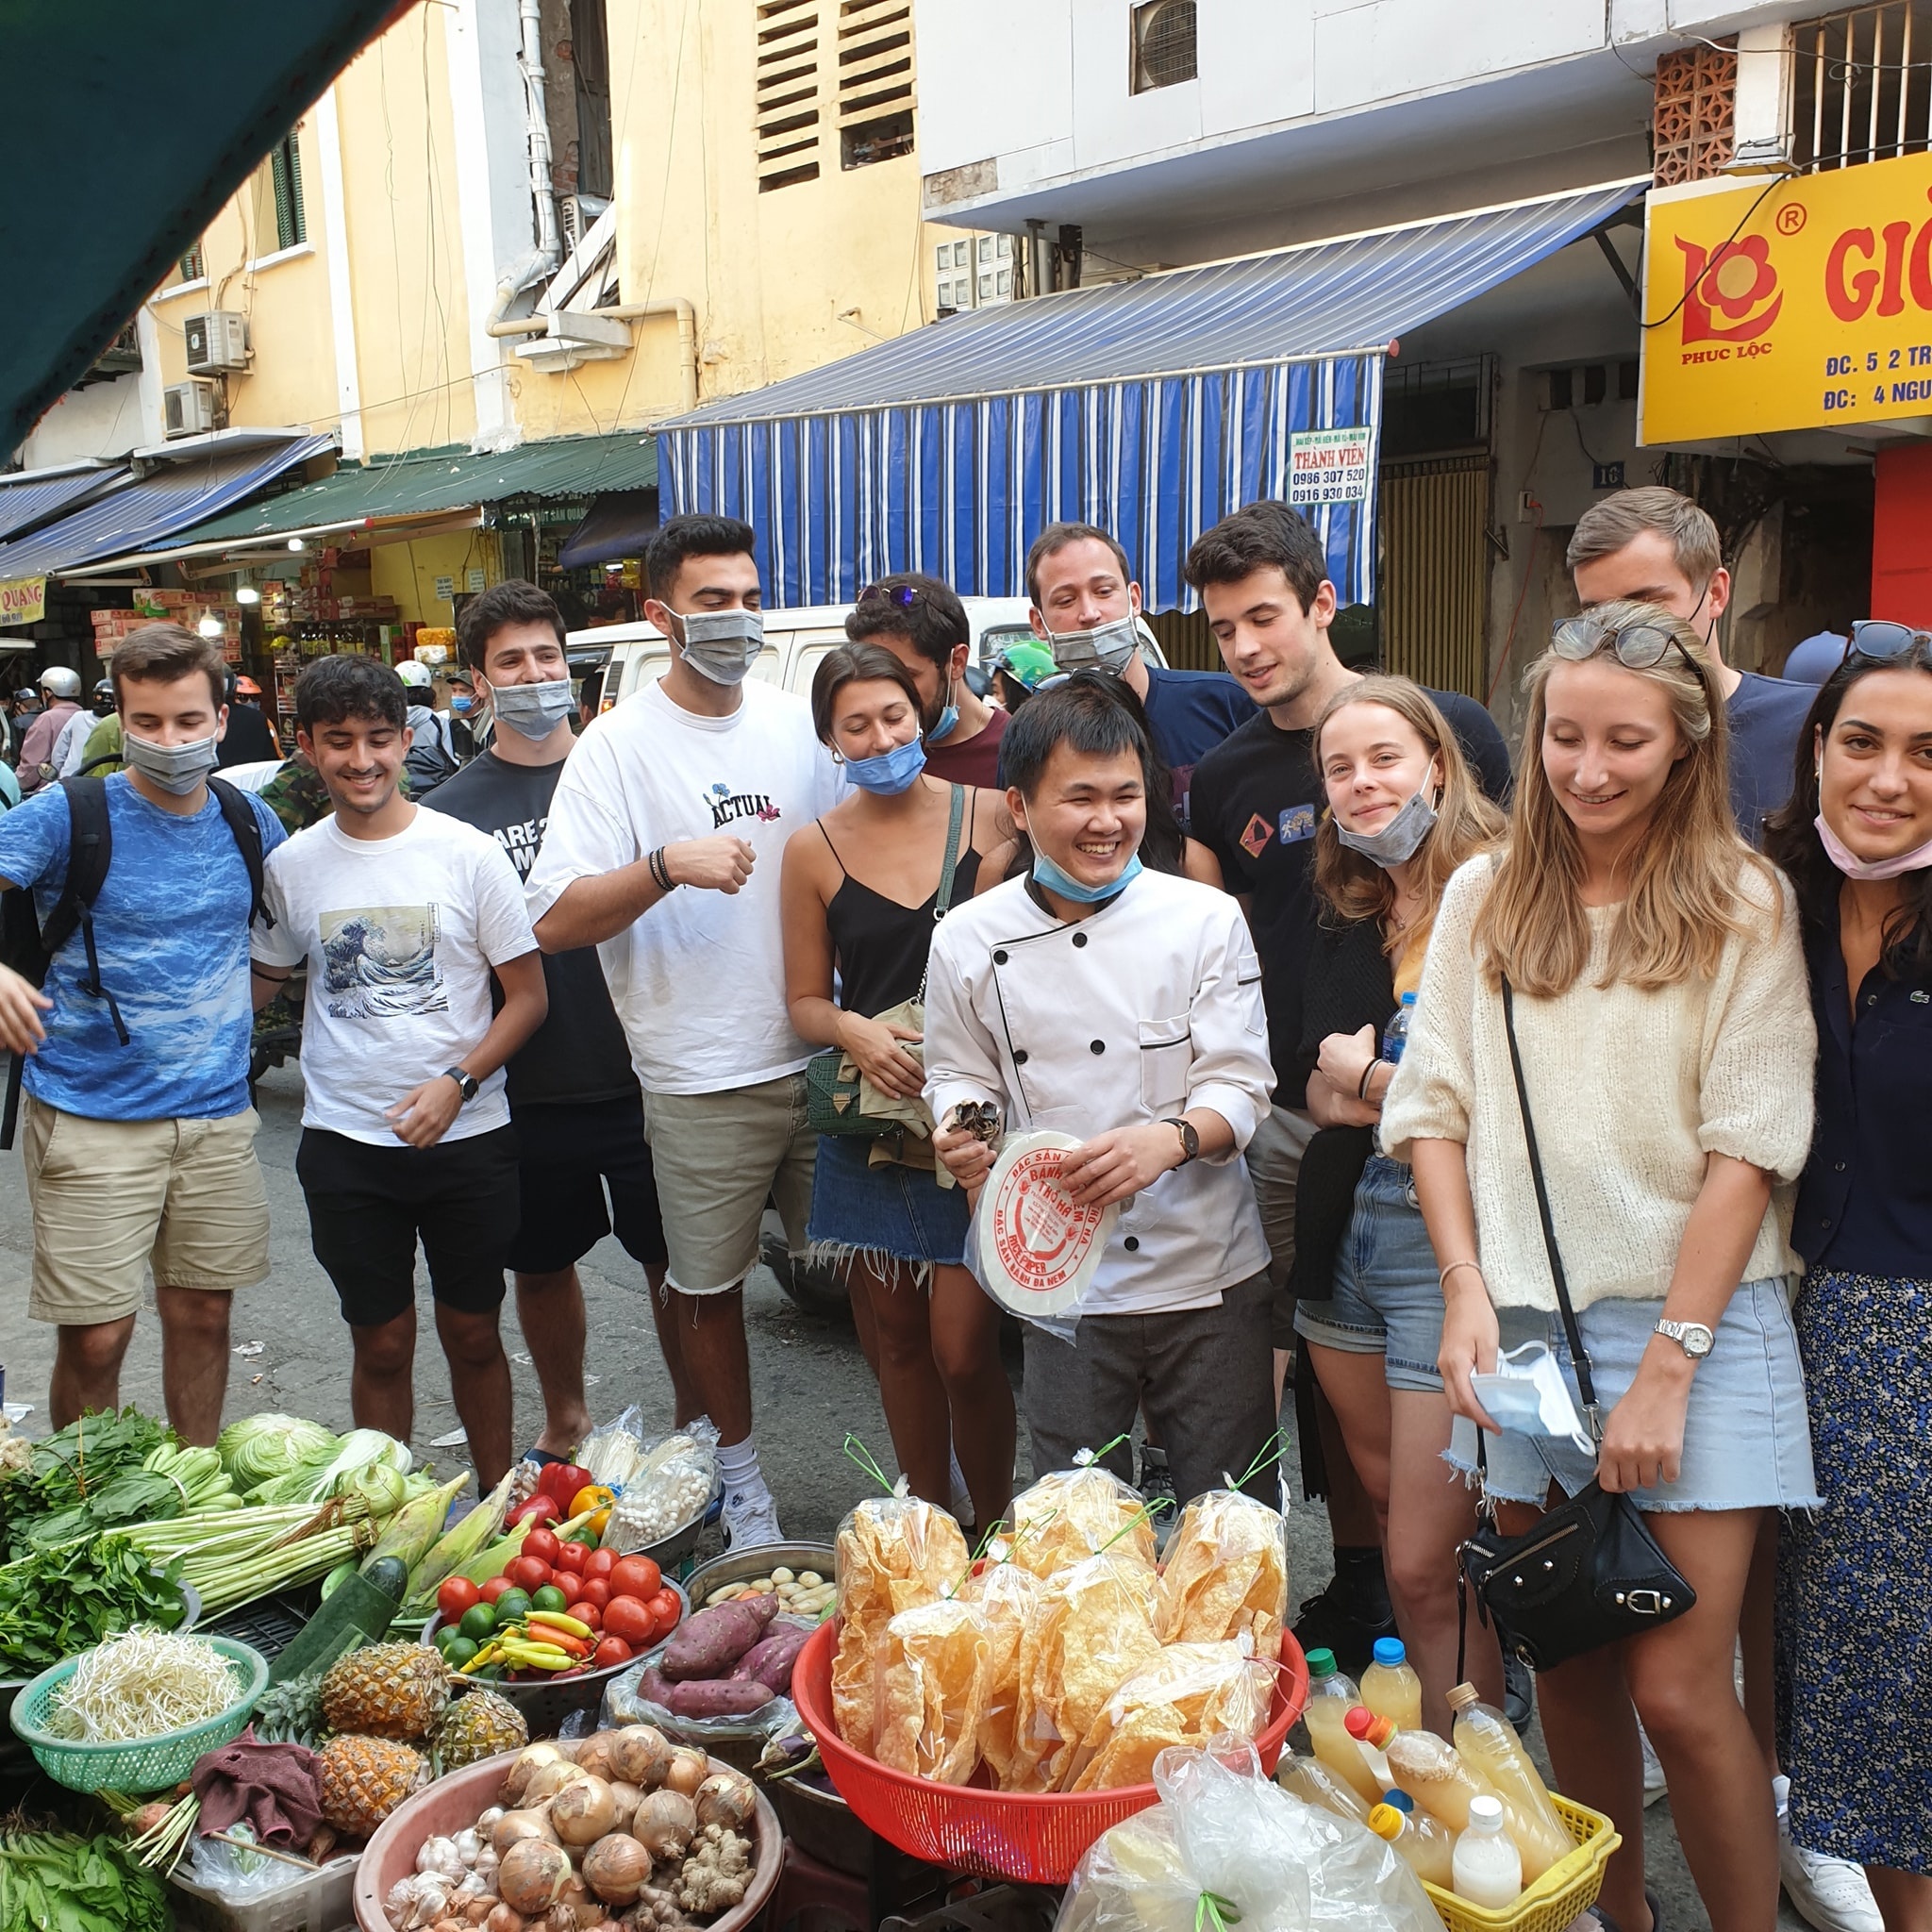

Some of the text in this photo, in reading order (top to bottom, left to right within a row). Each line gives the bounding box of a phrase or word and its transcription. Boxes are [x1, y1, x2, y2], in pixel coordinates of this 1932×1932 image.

[1737, 341, 1773, 359] LỘC
[1294, 442, 1365, 470] THÀNH VIÊN
[1293, 468, 1365, 485] 0986 307 520
[1292, 485, 1363, 502] 0916 930 034
[493, 819, 539, 849] ARE
